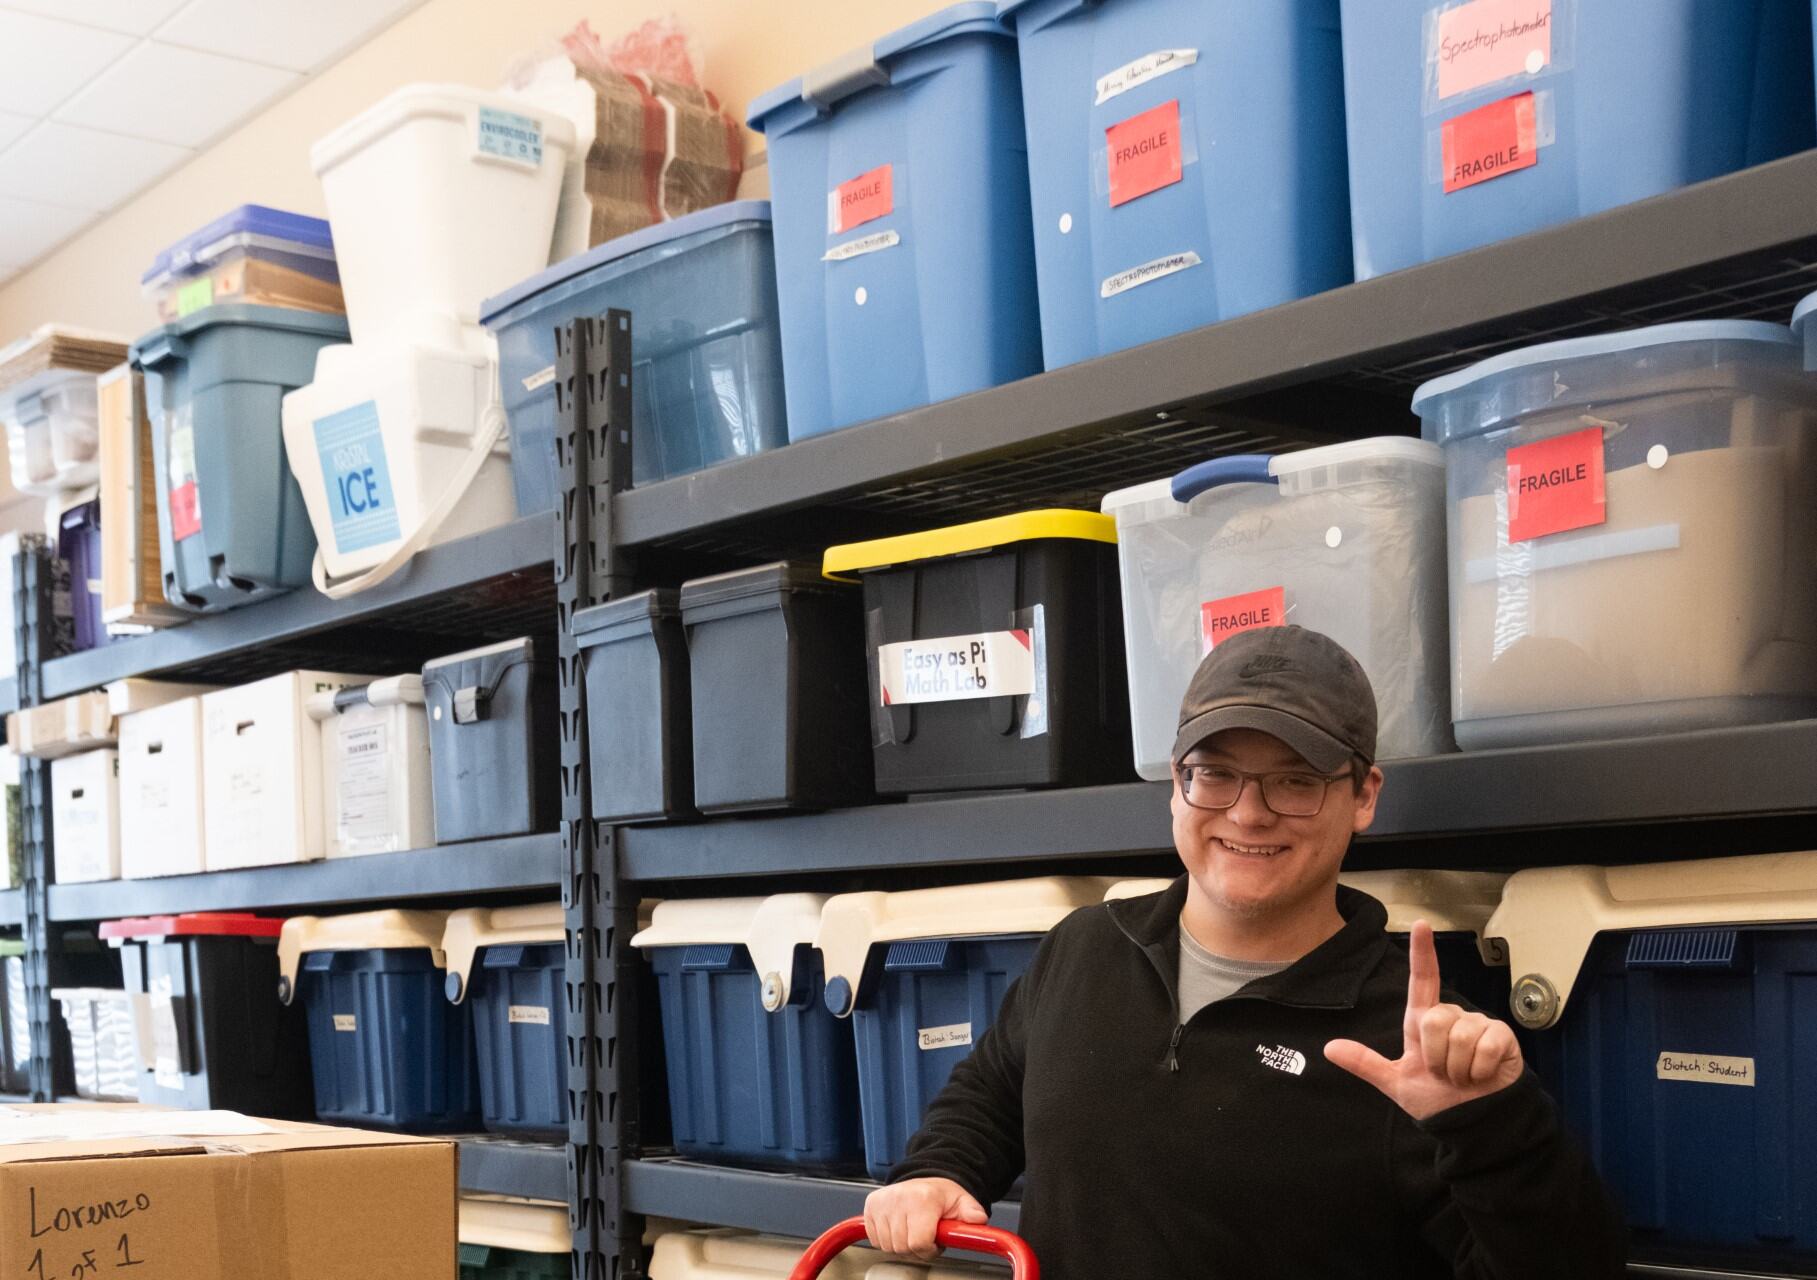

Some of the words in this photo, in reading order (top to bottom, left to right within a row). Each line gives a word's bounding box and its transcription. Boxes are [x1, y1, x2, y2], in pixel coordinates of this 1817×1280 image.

[1441, 12, 1551, 64] Spectrophotometer
[1116, 132, 1167, 165] FRAGILE
[1453, 145, 1519, 182] FRAGILE
[841, 182, 881, 208] FRAGILE
[338, 467, 380, 516] ICE
[1519, 464, 1586, 494] FRAGILE
[1211, 608, 1270, 632] FRAGILE
[904, 648, 942, 671] Easy
[947, 650, 966, 666] as
[970, 641, 986, 664] Pi
[906, 671, 949, 694] Math
[955, 667, 987, 692] Lab
[1256, 1043, 1292, 1065] NORTH
[1261, 1056, 1287, 1071] FACE
[1276, 1044, 1295, 1058] THE
[1708, 1061, 1747, 1078] Student
[30, 1186, 150, 1238] Lorenzo
[115, 1232, 145, 1267] 1
